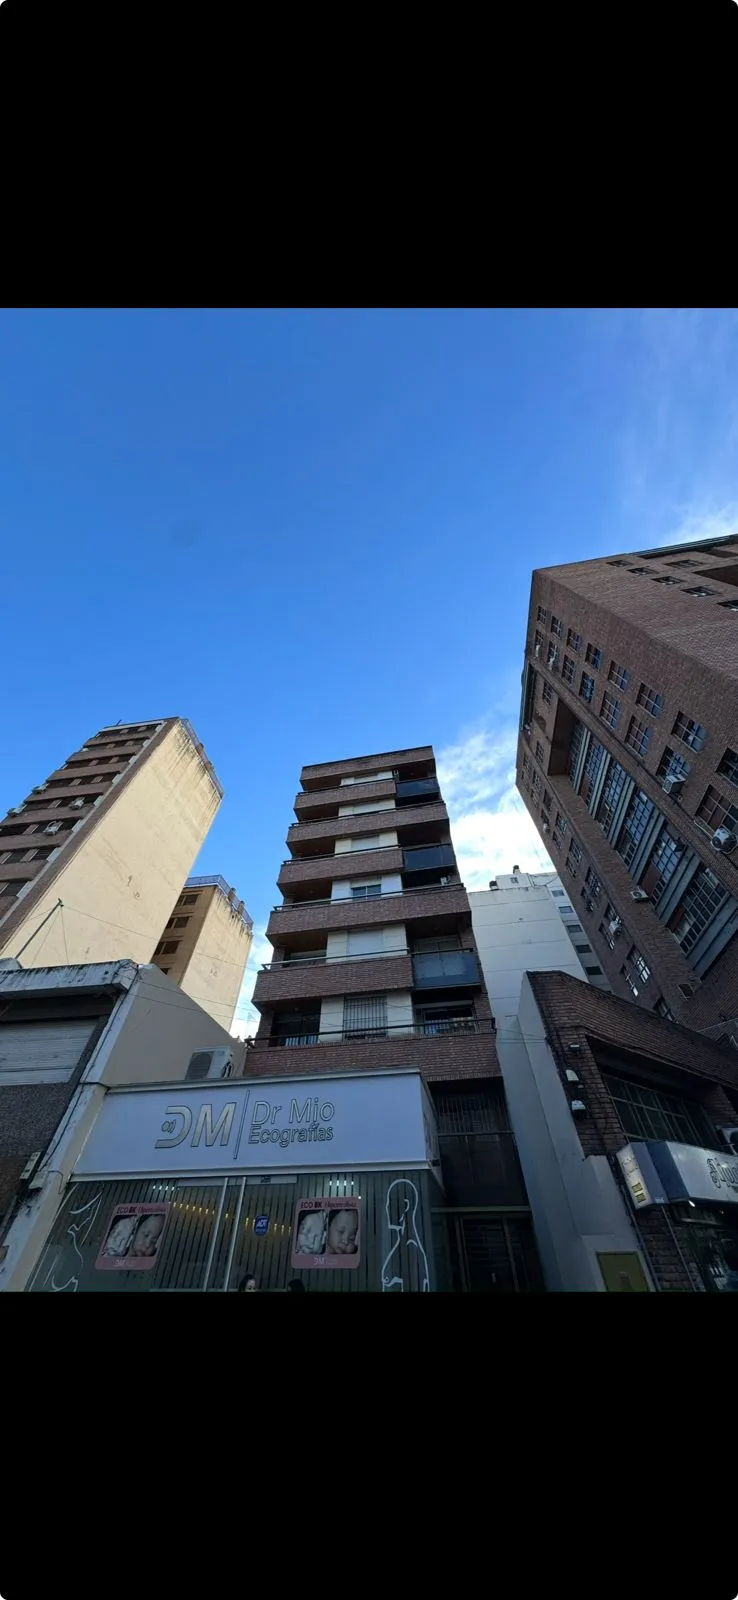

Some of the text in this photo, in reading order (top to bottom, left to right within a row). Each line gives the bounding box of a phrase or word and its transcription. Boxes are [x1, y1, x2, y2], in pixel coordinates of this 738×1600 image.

[155, 1101, 238, 1149] DM
[251, 1097, 335, 1125] Dr Mio
